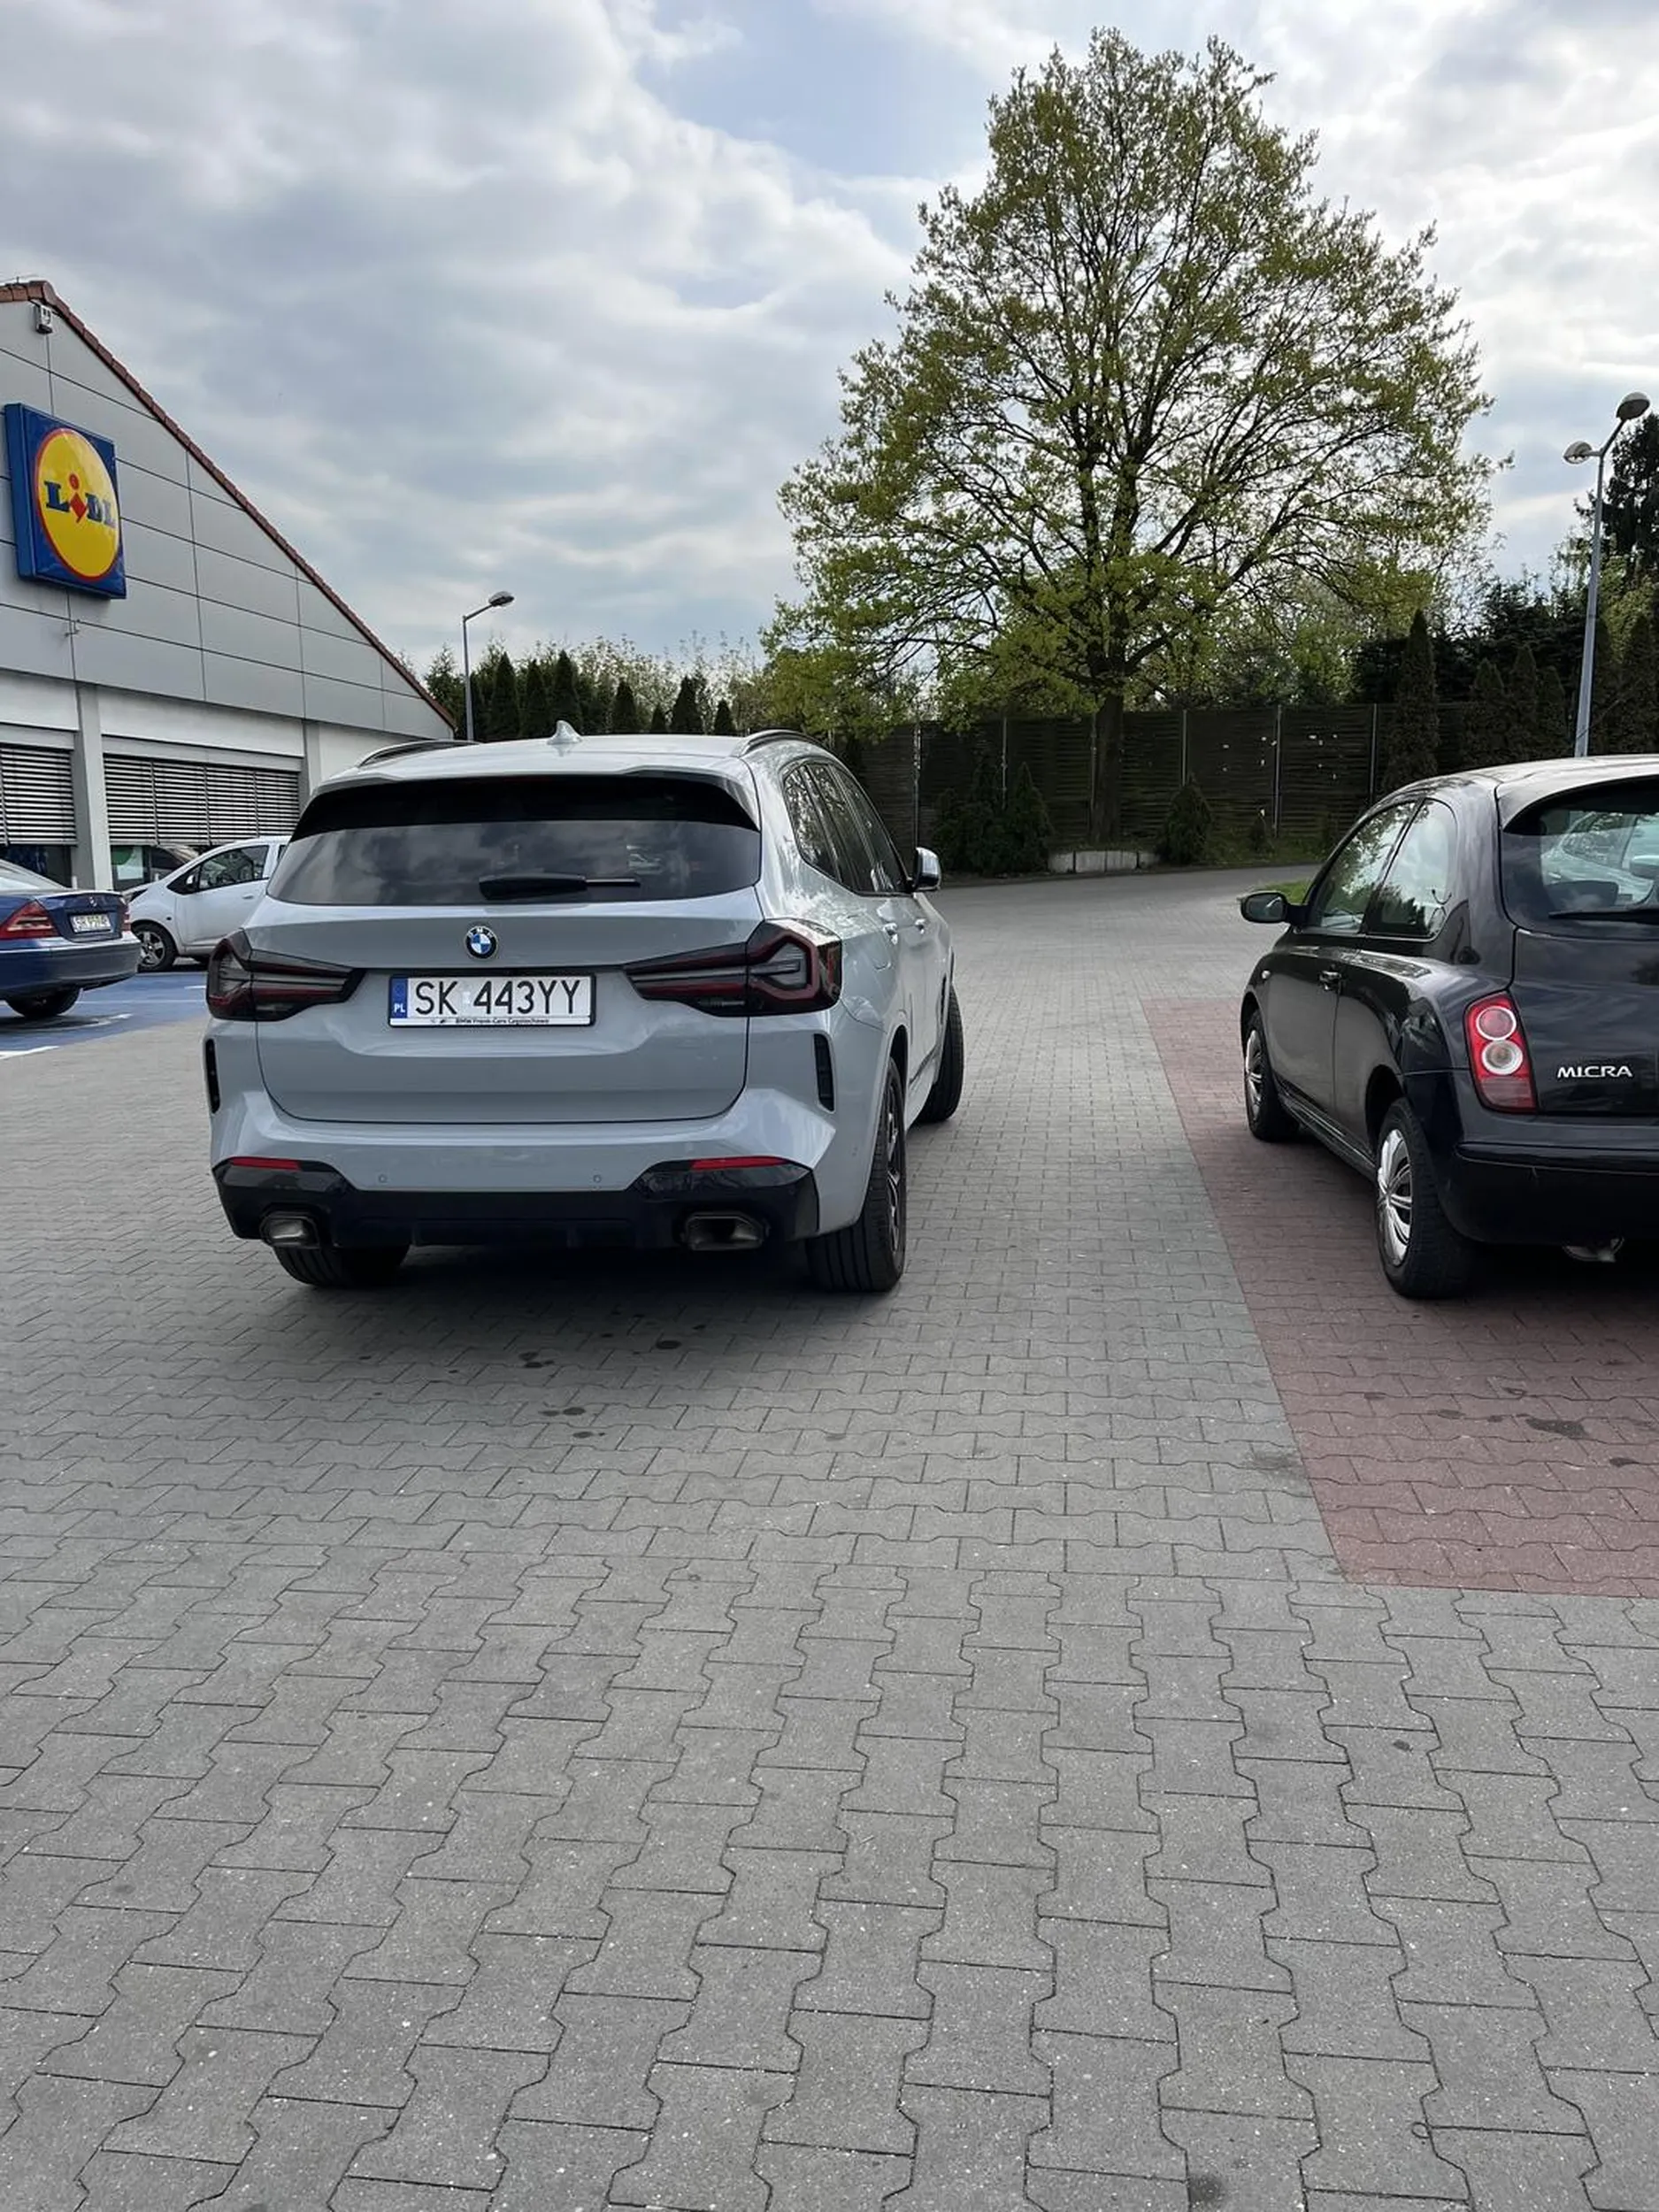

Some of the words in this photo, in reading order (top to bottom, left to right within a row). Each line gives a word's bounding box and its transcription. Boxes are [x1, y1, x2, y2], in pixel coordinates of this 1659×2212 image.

[415, 980, 457, 1015] SK
[473, 979, 580, 1015] 443YY
[394, 1003, 406, 1013] PL
[1557, 1065, 1633, 1078] MICRA
